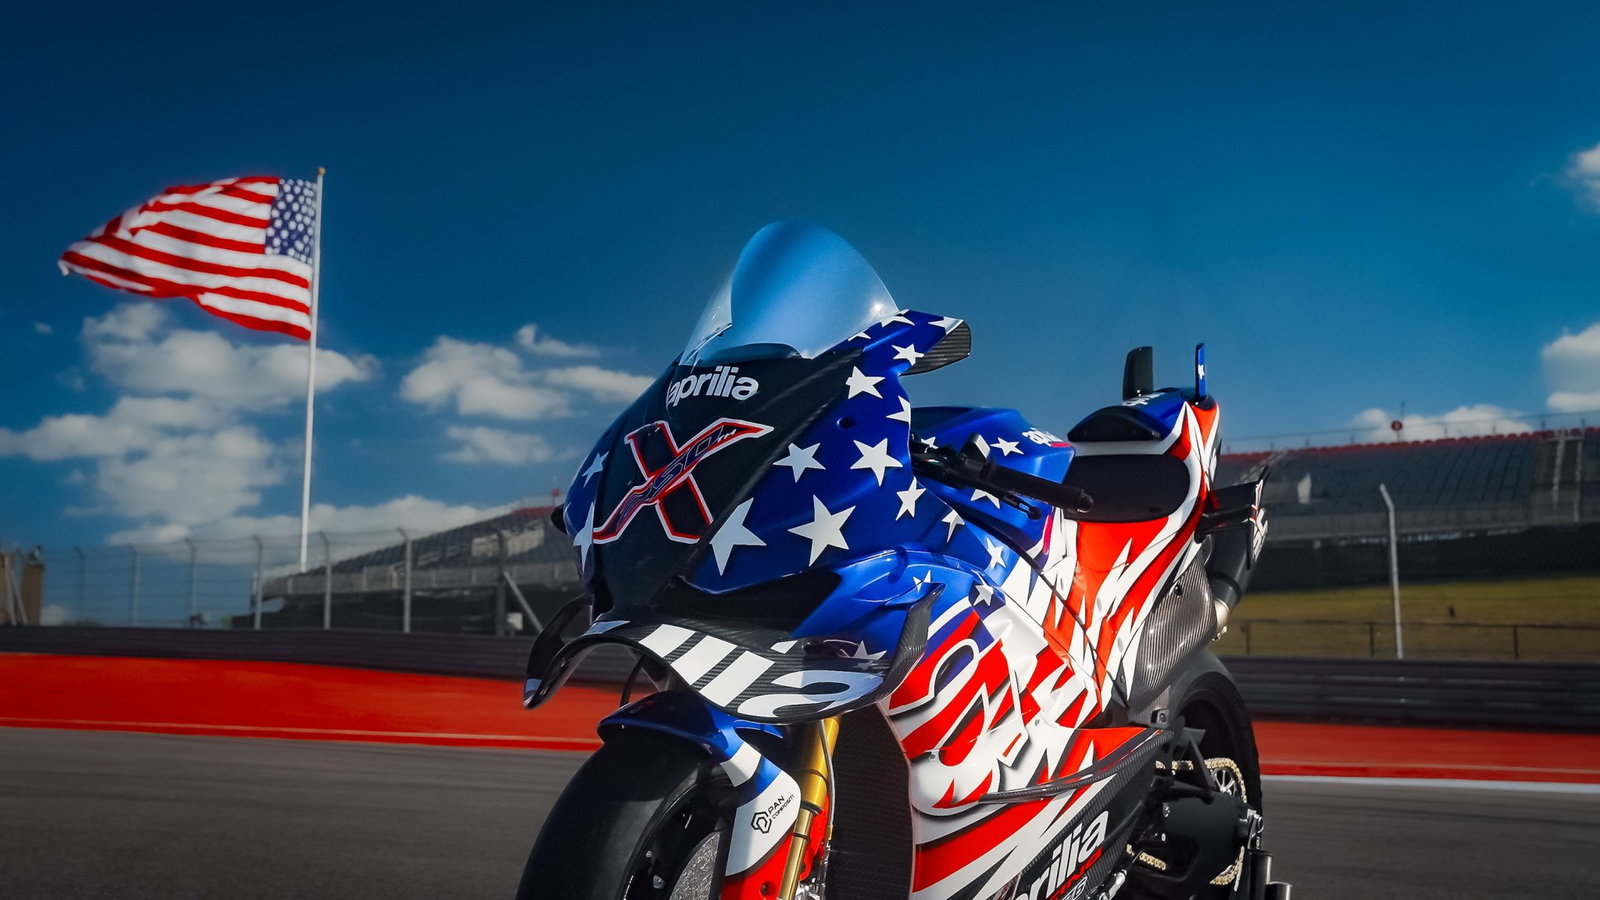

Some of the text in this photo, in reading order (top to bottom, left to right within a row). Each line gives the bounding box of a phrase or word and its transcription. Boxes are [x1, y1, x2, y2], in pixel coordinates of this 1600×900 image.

[666, 366, 759, 407] aprilia
[768, 796, 785, 814] PAN
[1015, 810, 1109, 900] rilia
